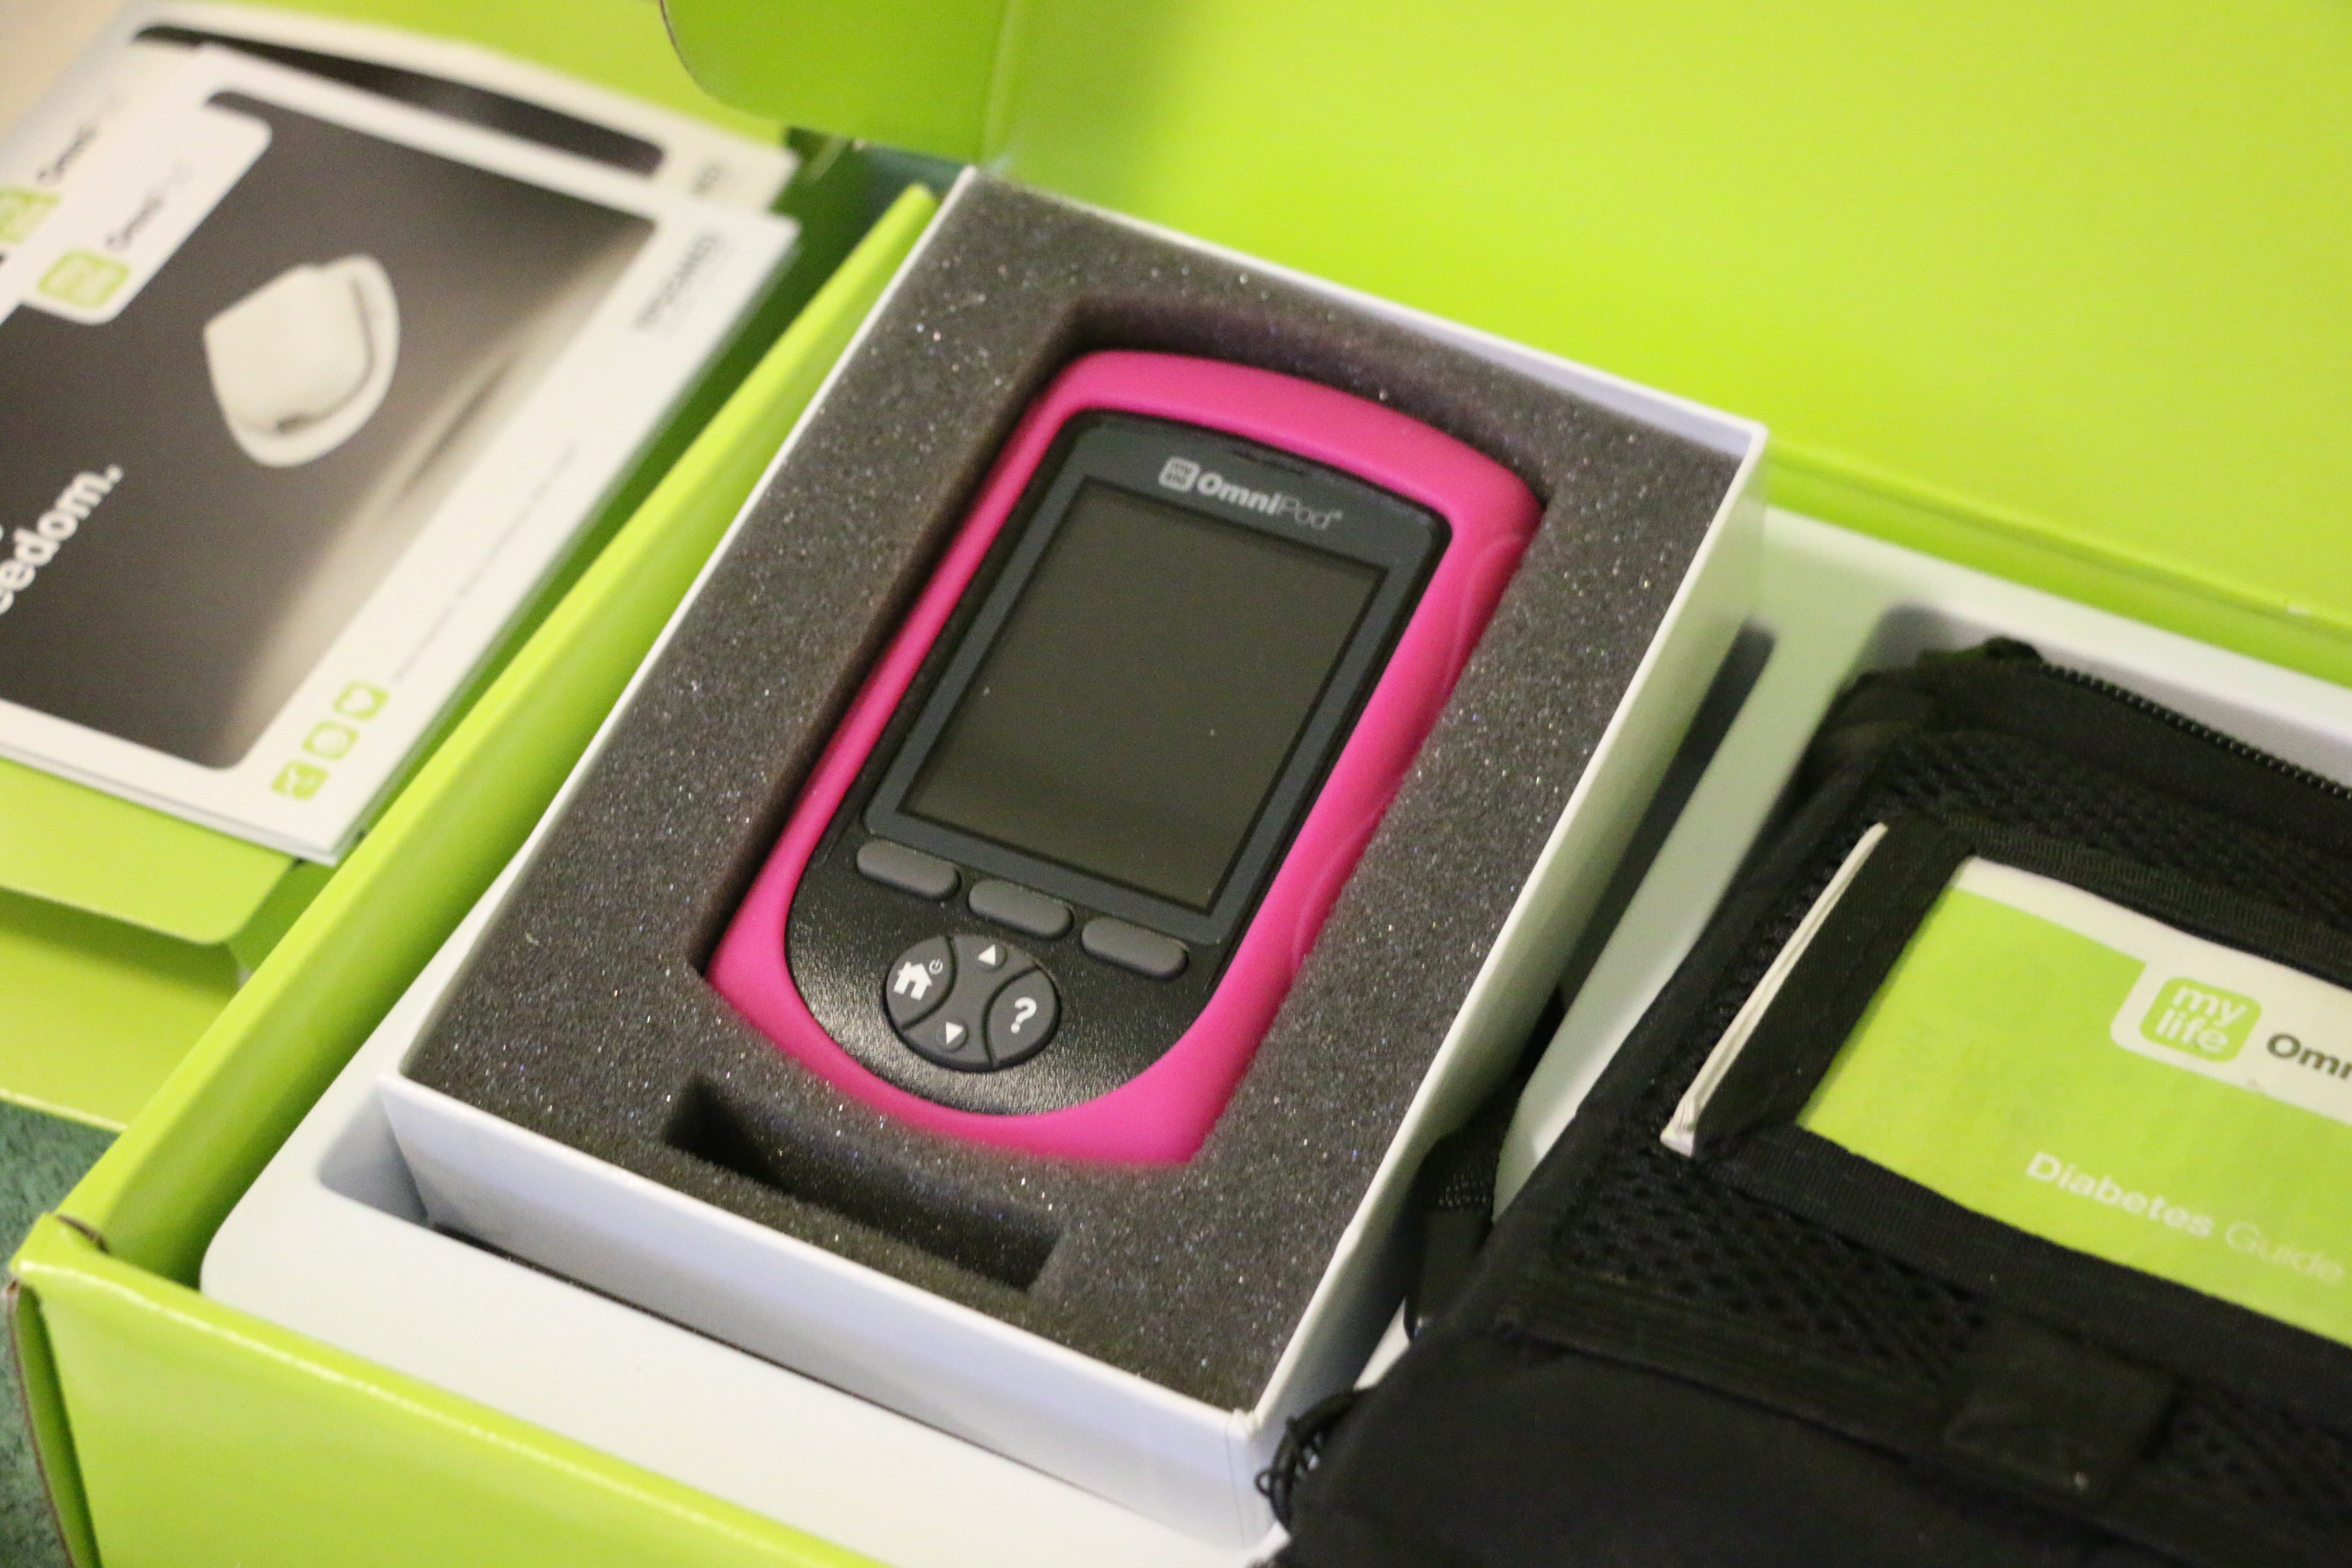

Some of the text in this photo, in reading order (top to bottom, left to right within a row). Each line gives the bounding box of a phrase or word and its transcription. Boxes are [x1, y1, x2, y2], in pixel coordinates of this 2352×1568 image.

[2171, 986, 2248, 1027] my
[2155, 1009, 2229, 1053] life
[2026, 1152, 2345, 1285] Diabetes Guide
